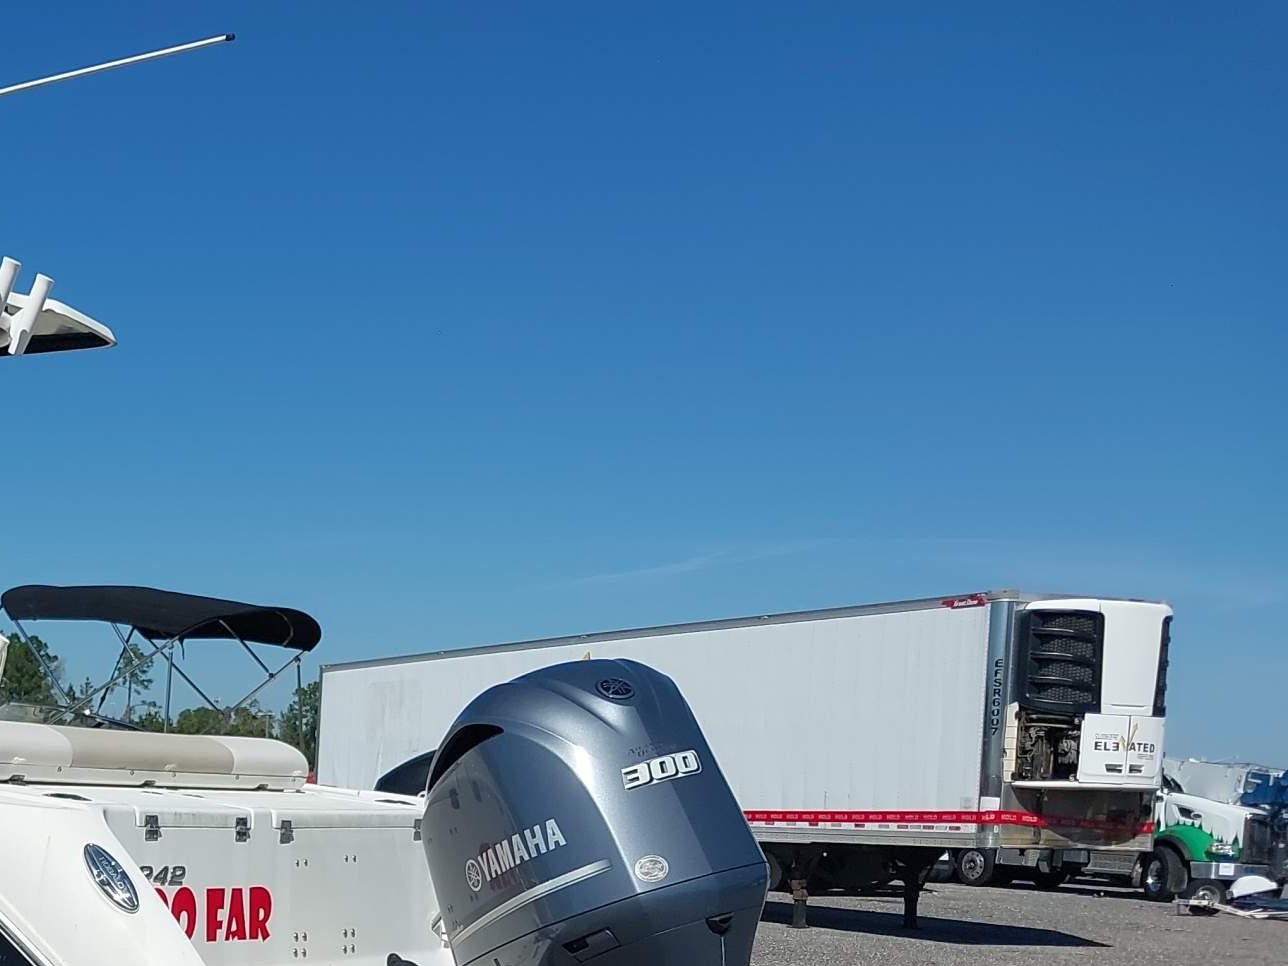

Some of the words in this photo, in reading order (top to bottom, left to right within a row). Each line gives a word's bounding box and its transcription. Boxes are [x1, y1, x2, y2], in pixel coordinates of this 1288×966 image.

[991, 658, 1004, 736] EFSR6007
[621, 750, 702, 790] 300
[478, 819, 567, 881] YAMAHA
[154, 886, 197, 940] O
[206, 886, 272, 942] FAR
